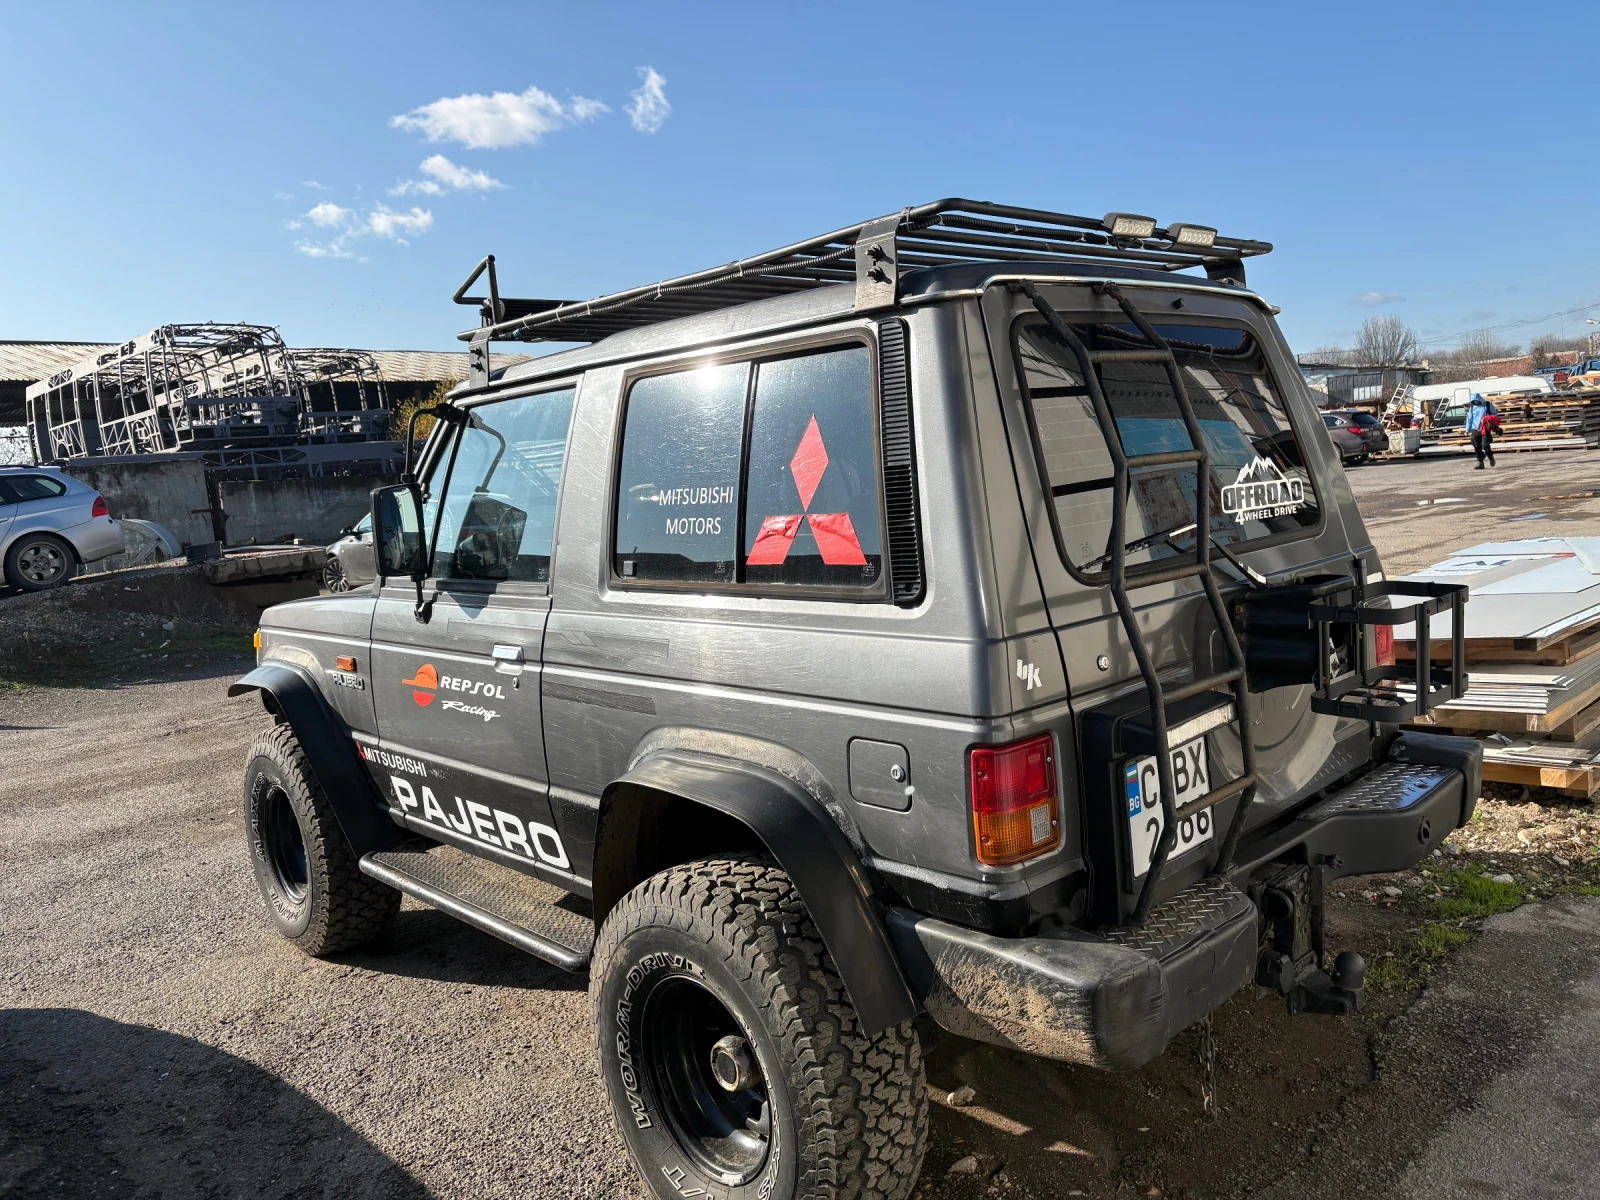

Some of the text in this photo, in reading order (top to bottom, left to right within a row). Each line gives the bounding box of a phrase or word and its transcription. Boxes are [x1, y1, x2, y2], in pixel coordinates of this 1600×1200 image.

[659, 486, 734, 506] MITSUBISHI
[1222, 478, 1304, 514] OFFROAD
[1274, 505, 1298, 517] DRIVE
[666, 517, 721, 535] MOTORS
[333, 673, 365, 691] PAJERO
[440, 675, 506, 700] REPSOL
[441, 700, 501, 722] Racing
[363, 746, 428, 778] MITSUBISHI
[1129, 795, 1141, 812] BG
[390, 775, 570, 869] PAJERO
